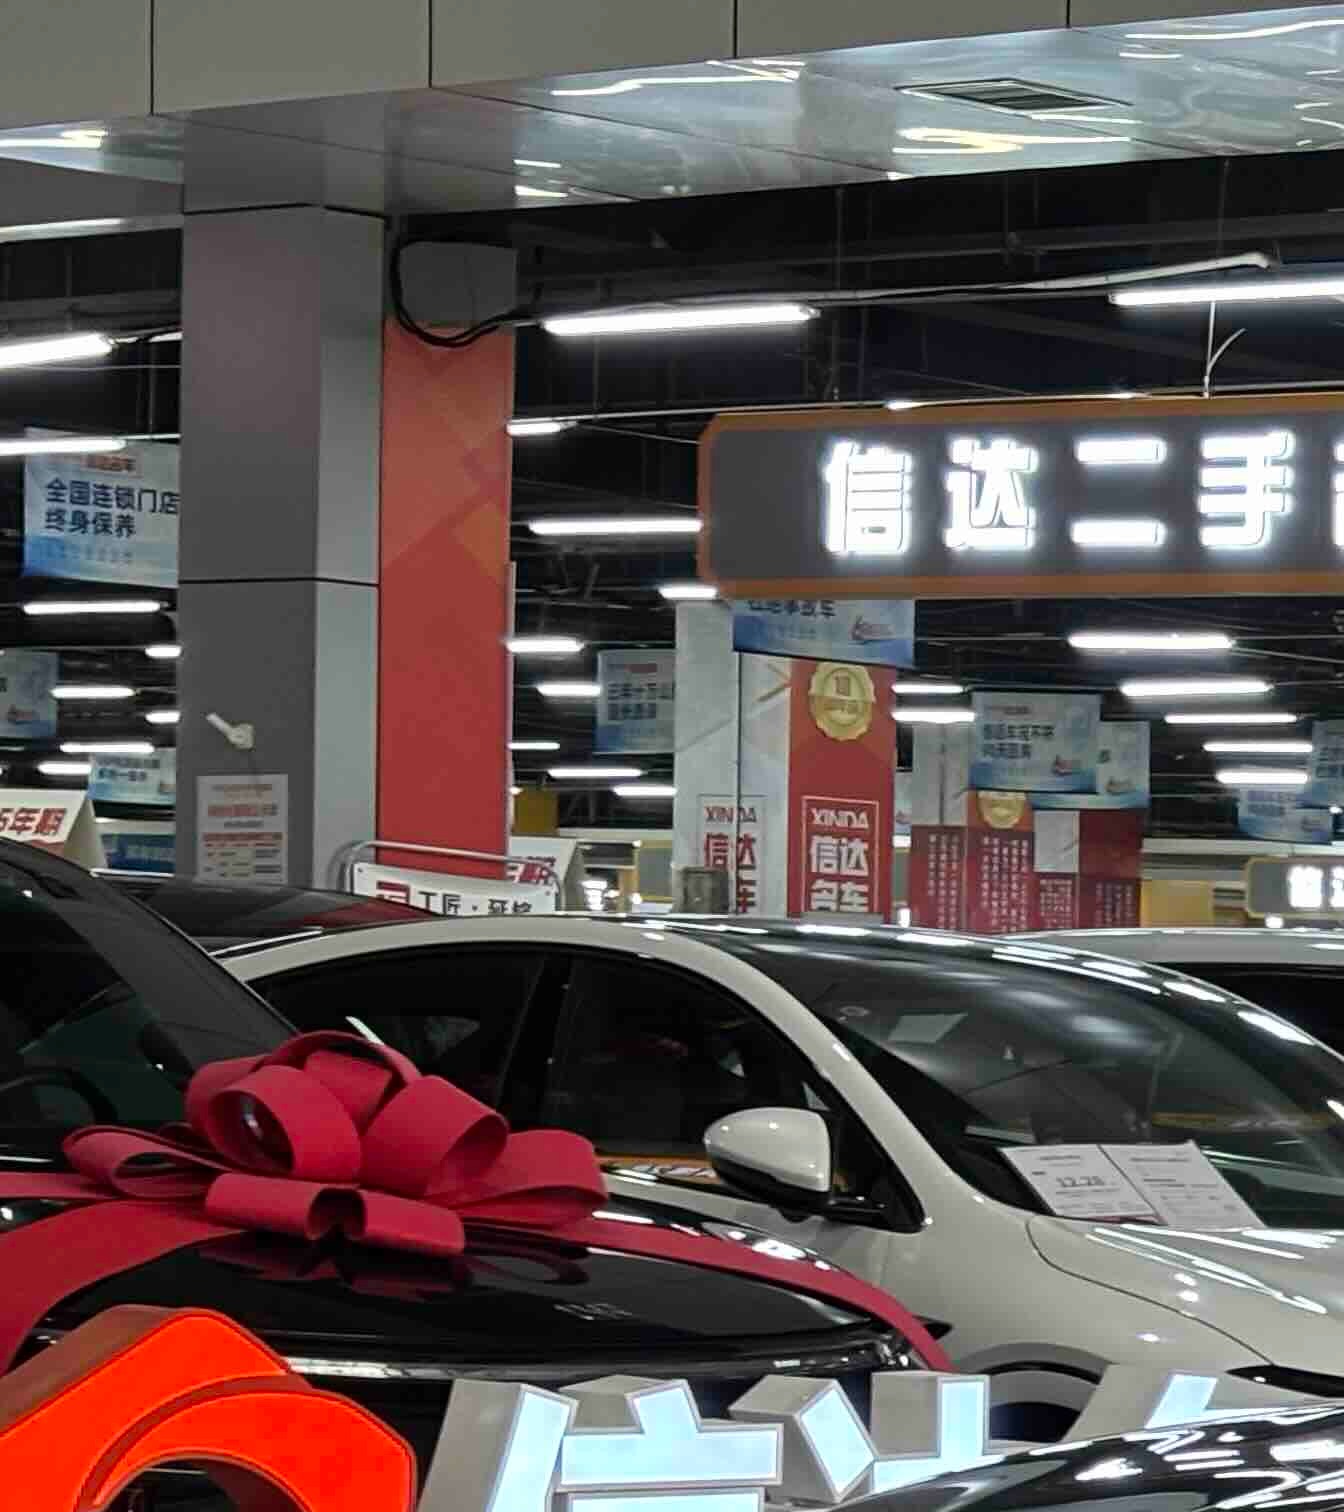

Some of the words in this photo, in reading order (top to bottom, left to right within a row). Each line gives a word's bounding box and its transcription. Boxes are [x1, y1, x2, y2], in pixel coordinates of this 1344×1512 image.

[45, 476, 181, 515] 全国连锁门店
[45, 508, 136, 538] 终身保养
[810, 807, 869, 829] XINDA
[809, 834, 869, 877] 信达
